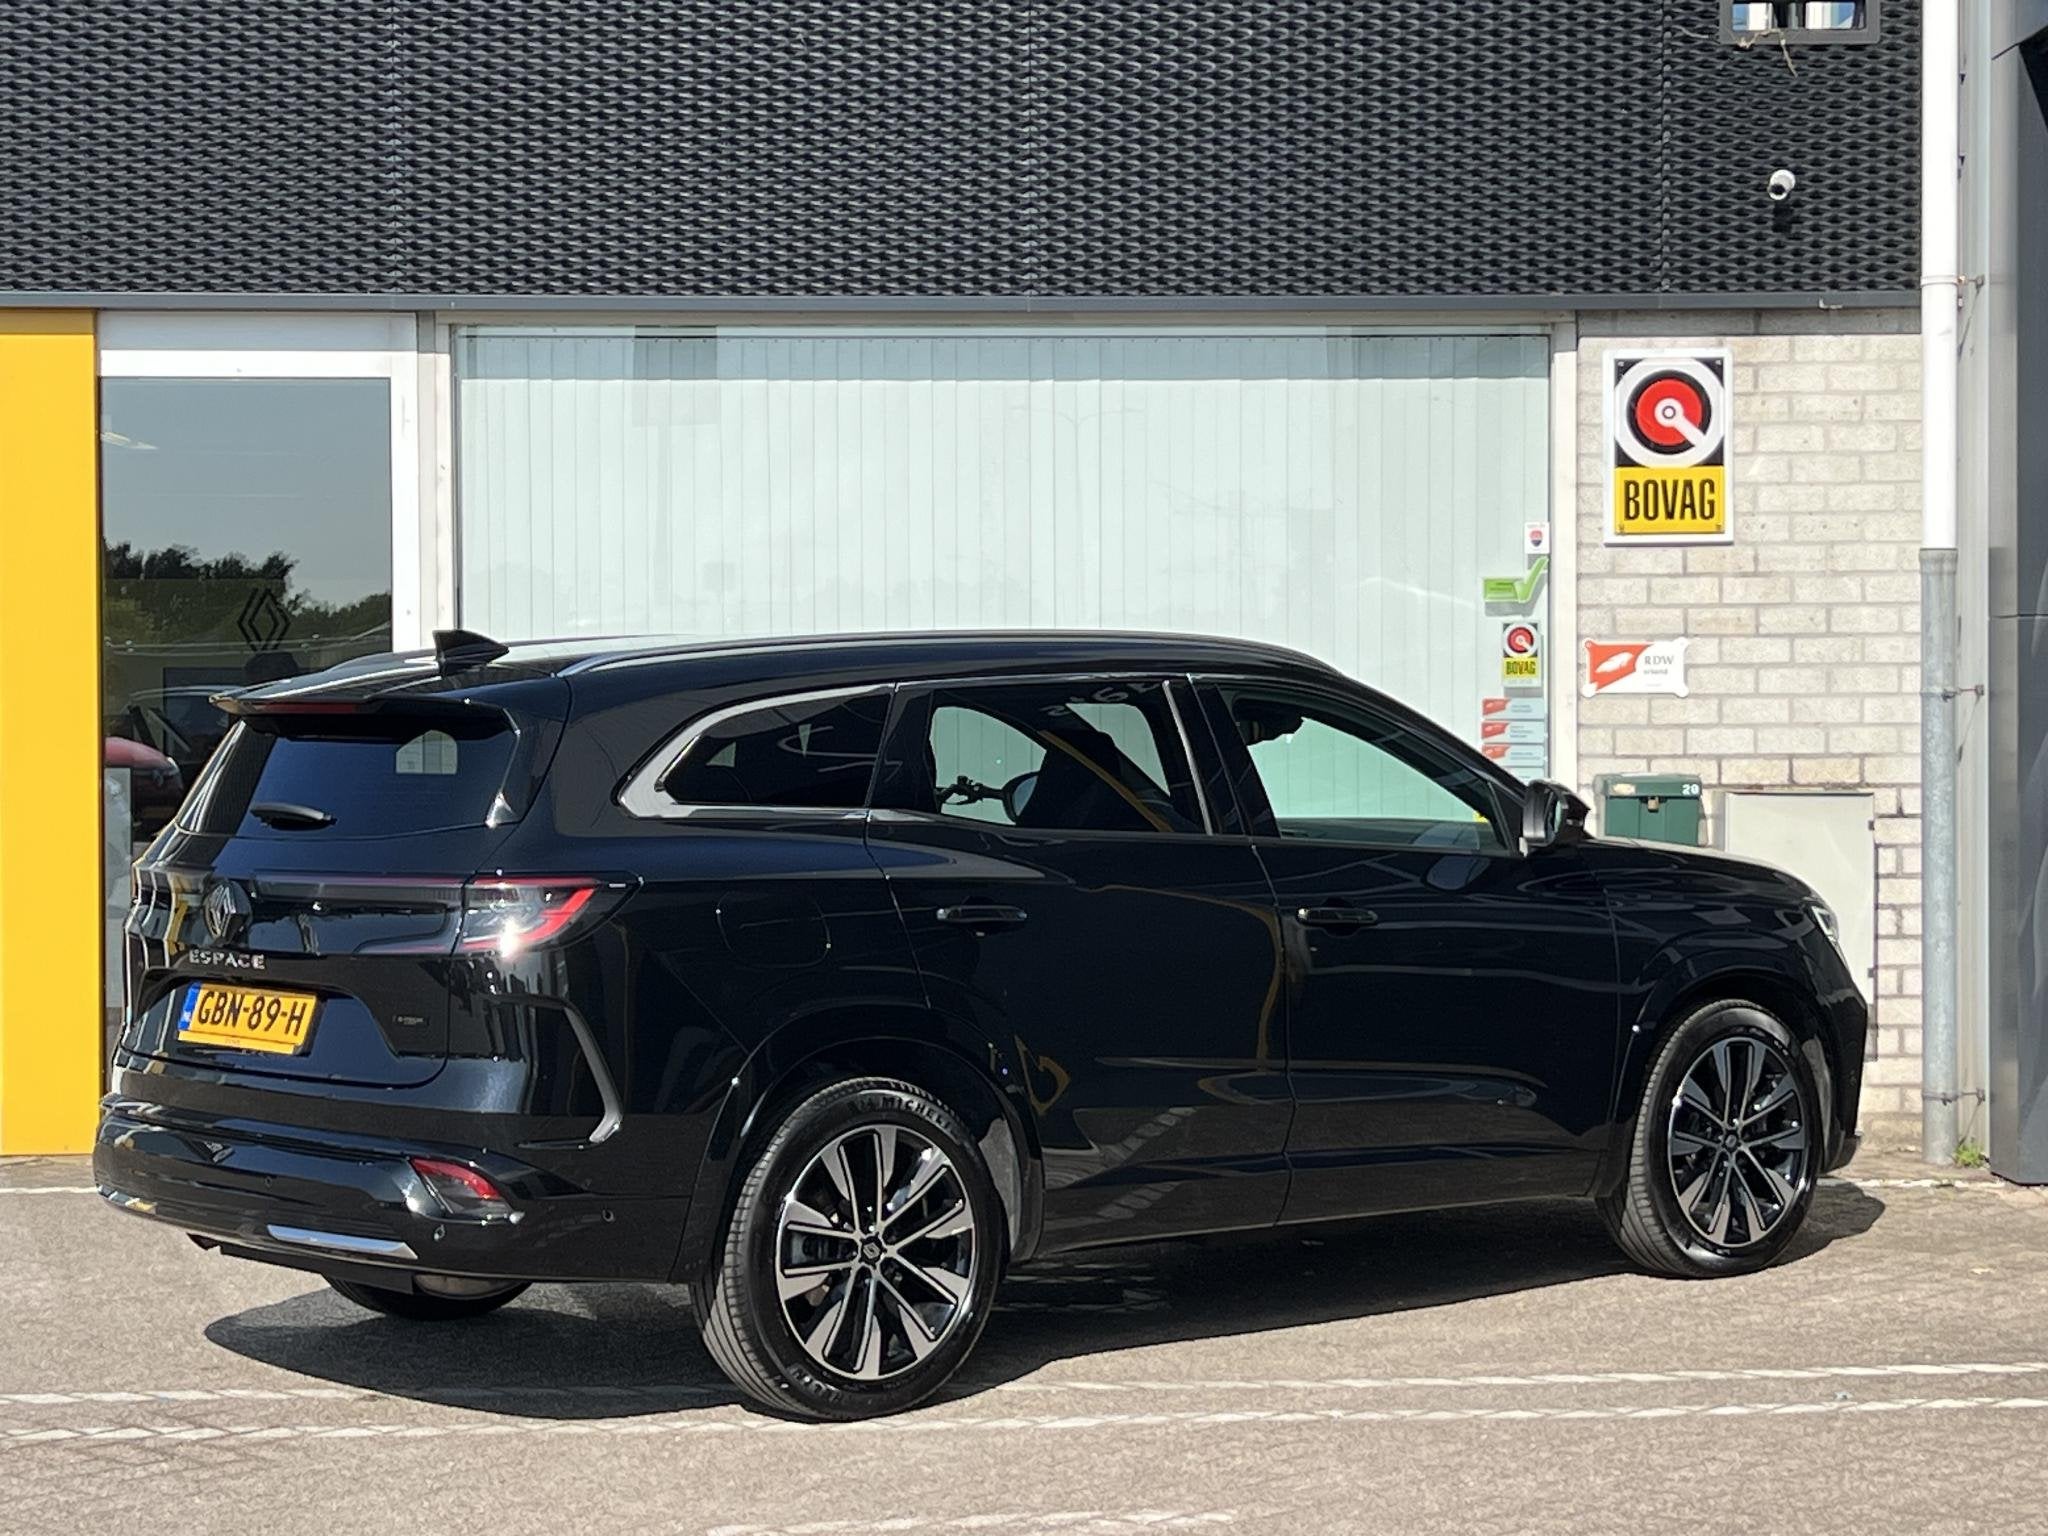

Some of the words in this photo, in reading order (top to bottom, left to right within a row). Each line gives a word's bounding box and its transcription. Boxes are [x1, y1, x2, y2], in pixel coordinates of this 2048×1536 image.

[1624, 479, 1715, 521] BOVAG
[1644, 655, 1674, 665] RDW
[189, 949, 265, 970] ESPACE
[198, 990, 307, 1036] GBN-89-H
[881, 1096, 958, 1137] MICHELI
